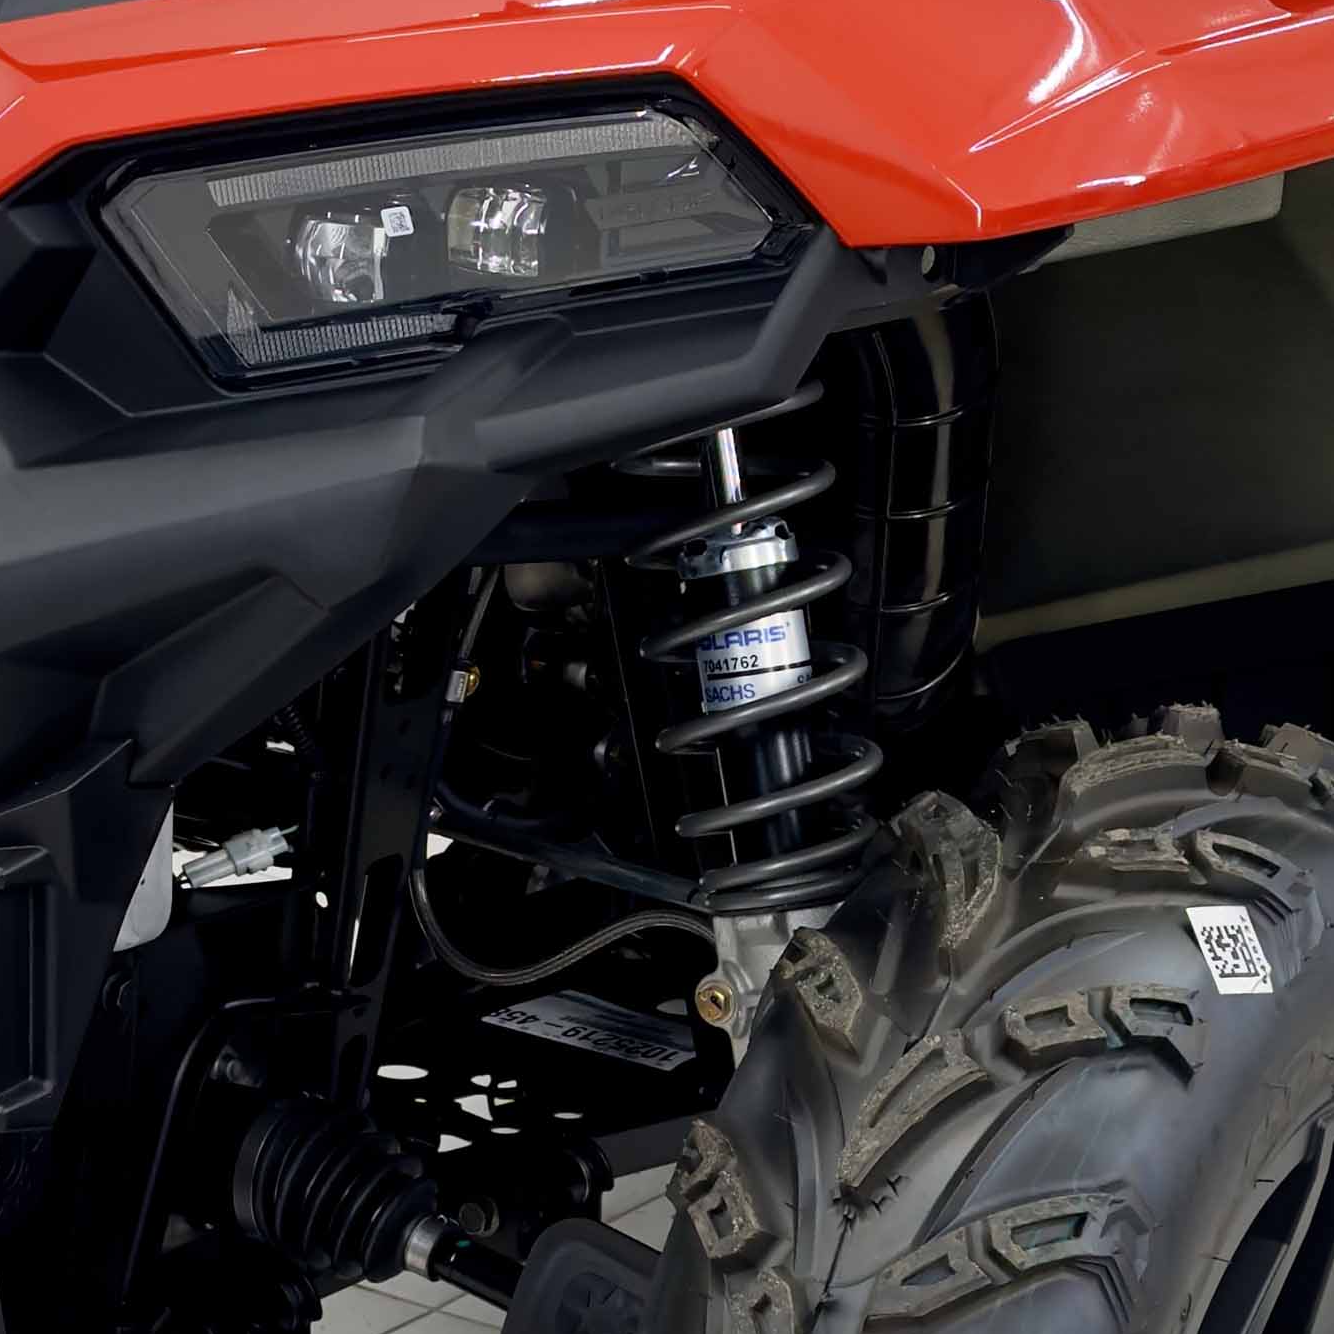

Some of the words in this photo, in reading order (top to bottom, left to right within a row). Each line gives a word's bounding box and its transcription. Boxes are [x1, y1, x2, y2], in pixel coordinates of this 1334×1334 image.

[699, 625, 786, 651] OLARIS
[704, 654, 759, 673] 7041762
[706, 683, 756, 703] SACHS
